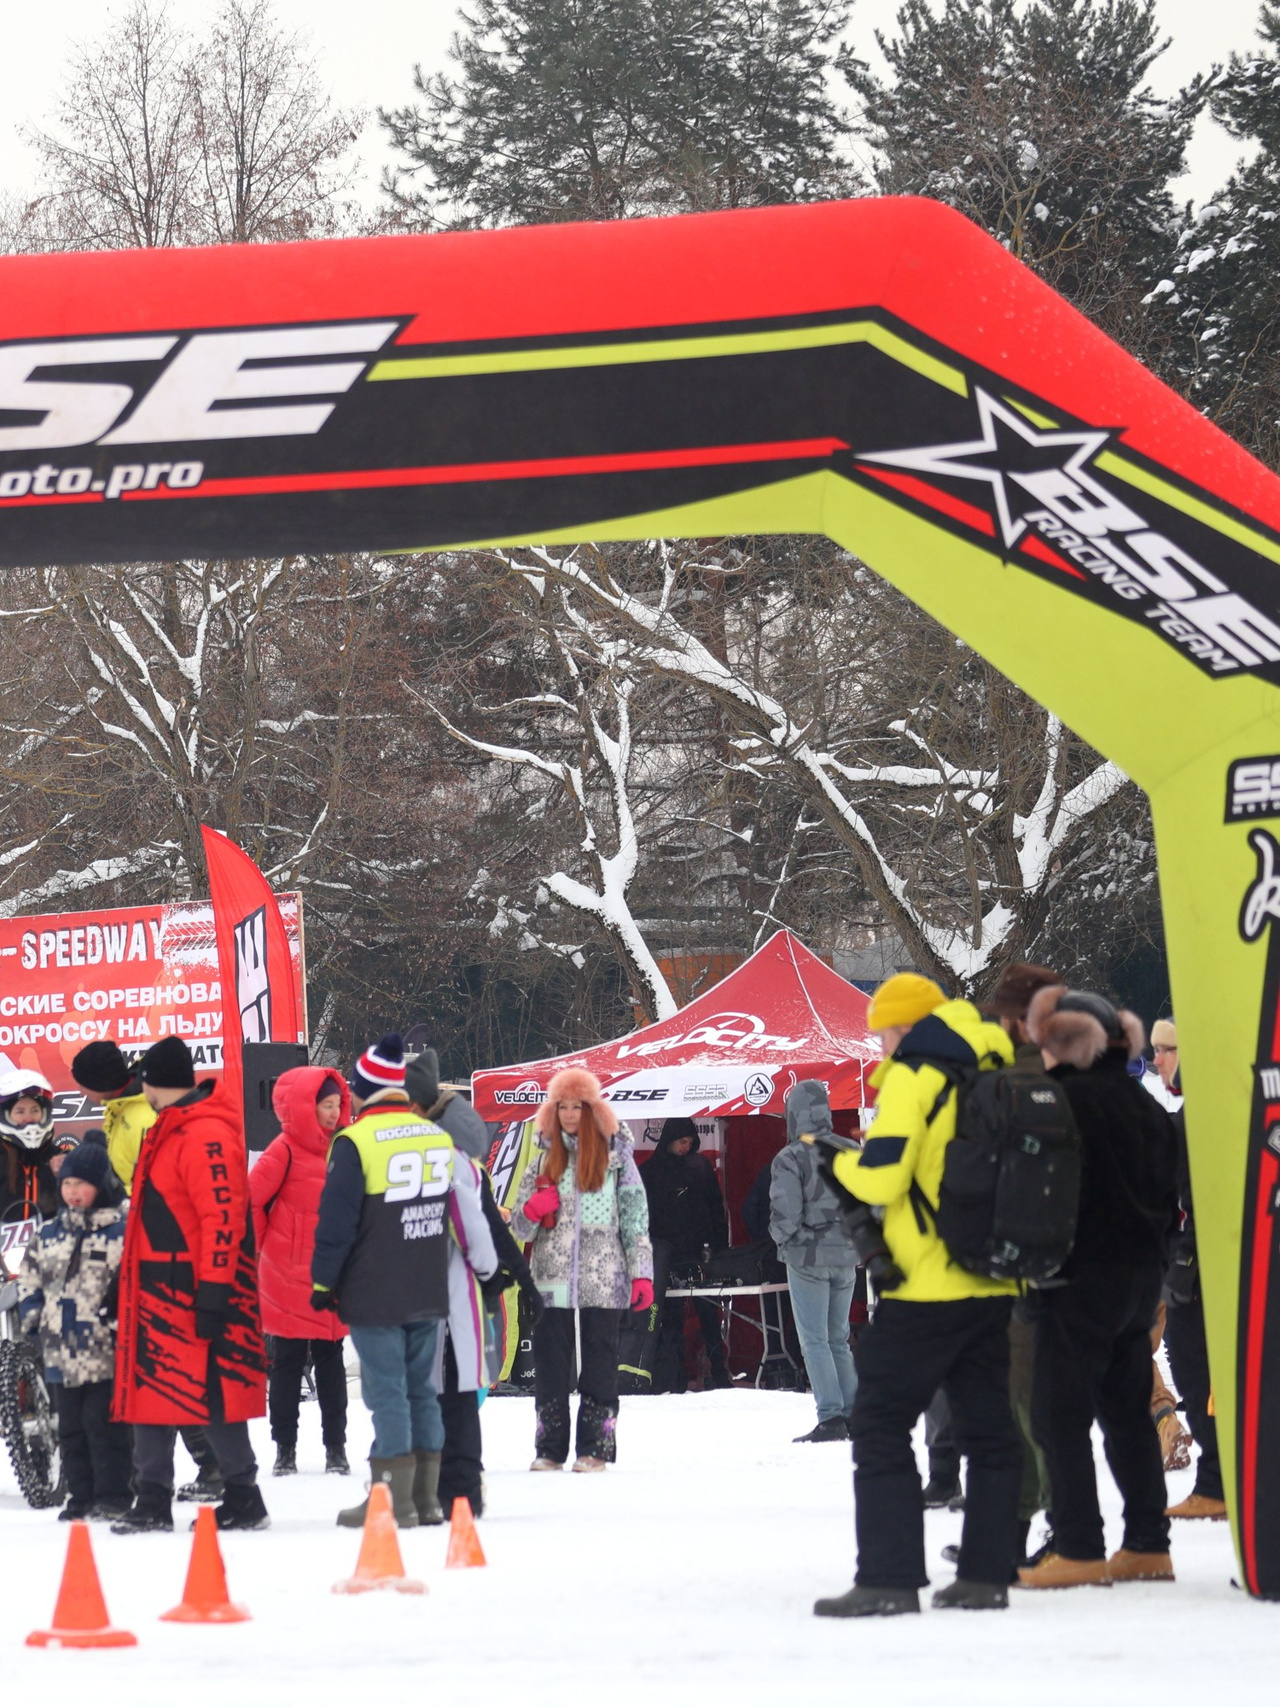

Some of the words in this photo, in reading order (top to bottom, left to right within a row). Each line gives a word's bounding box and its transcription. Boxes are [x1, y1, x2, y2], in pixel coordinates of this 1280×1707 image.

[1007, 468, 1280, 667] BSE
[1023, 511, 1147, 600] RACING
[1144, 602, 1240, 672] TEAM
[117, 1017, 149, 1038] НА
[158, 1011, 223, 1040] ЛЬДУ
[616, 1015, 811, 1060] VELOCITY
[494, 1085, 549, 1105] VELOCIT
[609, 1088, 670, 1102] BSE
[383, 1148, 452, 1204] 93
[204, 1141, 234, 1269] RACING
